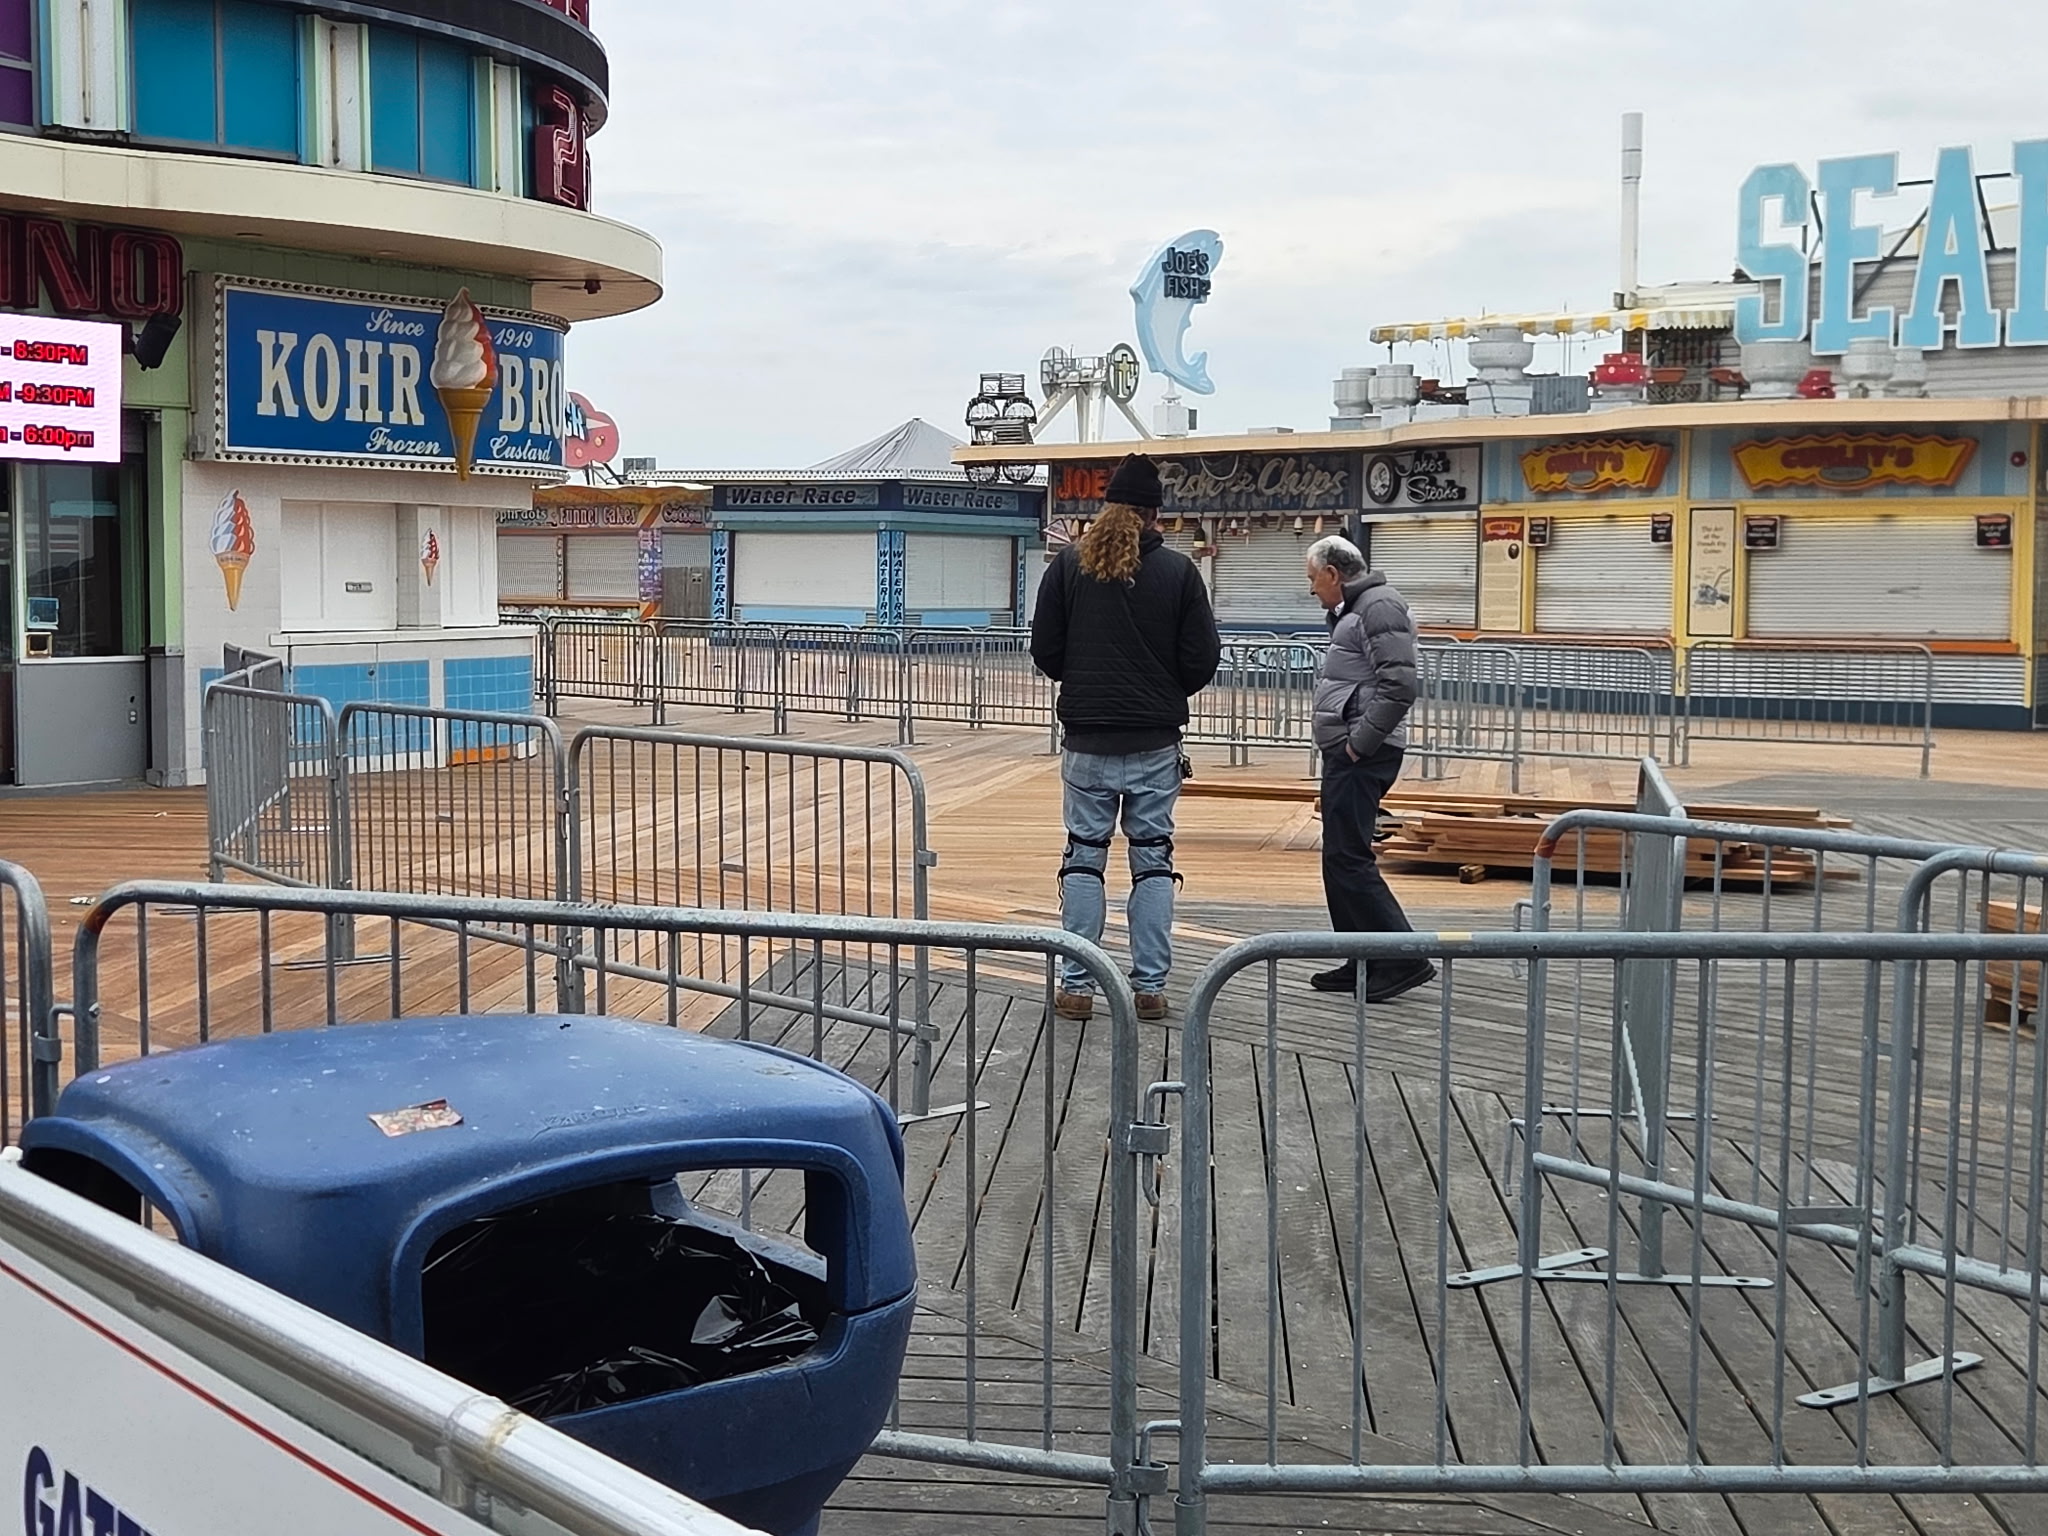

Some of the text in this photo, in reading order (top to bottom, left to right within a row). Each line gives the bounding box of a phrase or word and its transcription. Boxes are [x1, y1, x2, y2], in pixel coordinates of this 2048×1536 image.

[1162, 247, 1209, 275] JOE'S
[1164, 275, 1201, 299] FISH
[366, 308, 534, 348] Since 1919
[14, 340, 88, 365] 8:30PM
[256, 330, 425, 426] KOHR
[24, 424, 94, 451] 6:00pm
[366, 427, 552, 462] Frozen Custard
[1056, 467, 1114, 500] JOE
[1258, 456, 1349, 506] Chips
[731, 486, 857, 505] Water Race
[907, 487, 1003, 509] Water Race
[559, 506, 637, 525] Funnel Cakes
